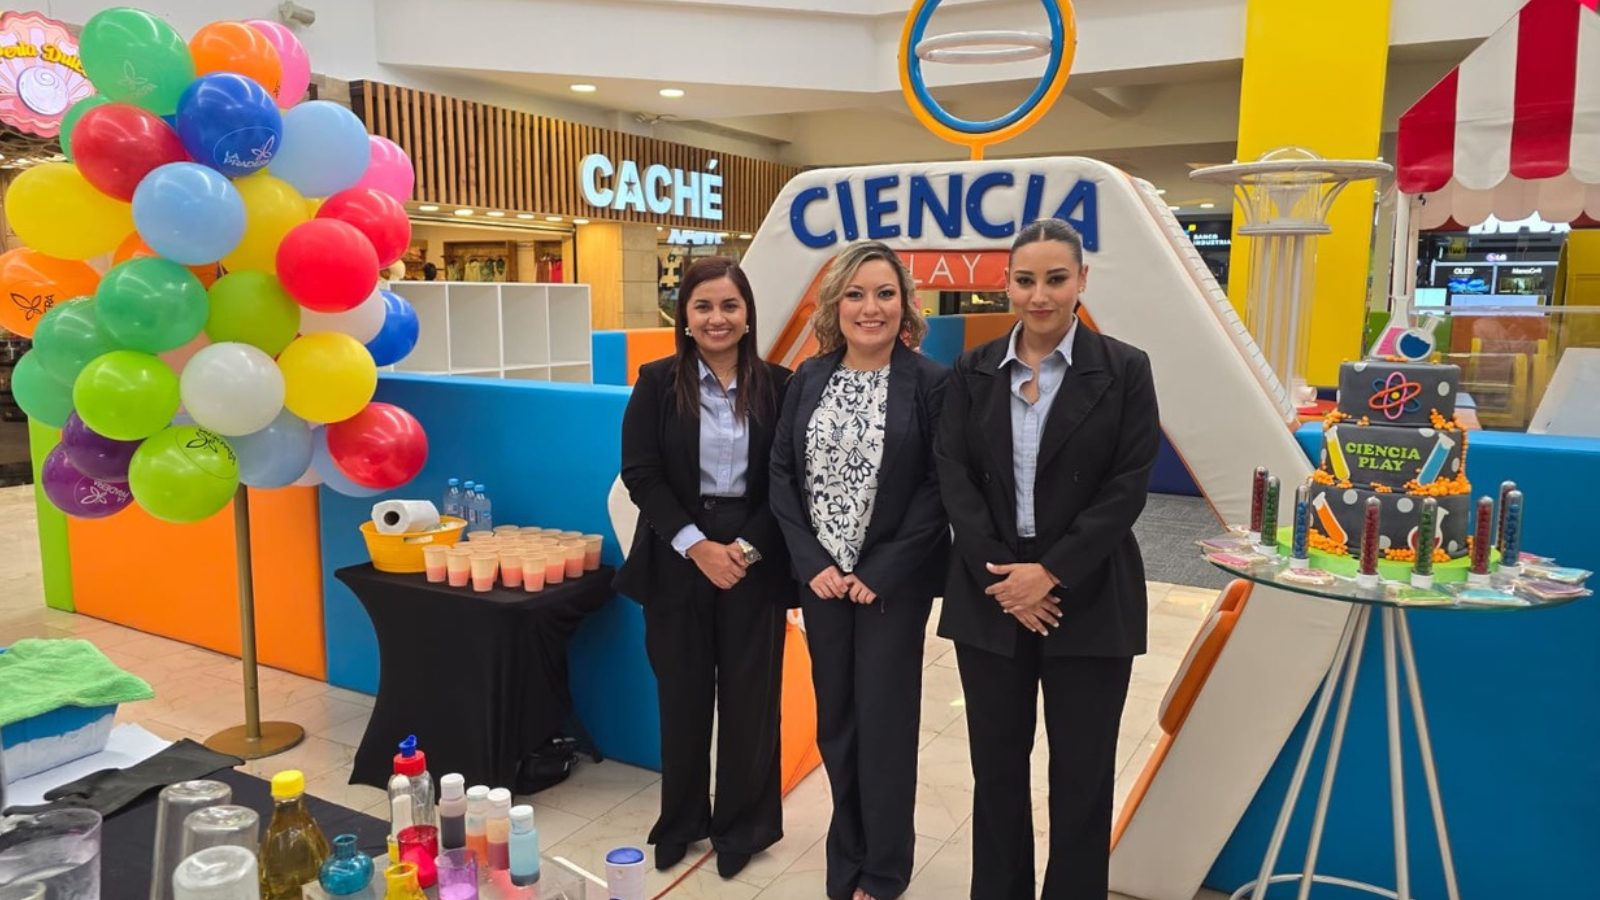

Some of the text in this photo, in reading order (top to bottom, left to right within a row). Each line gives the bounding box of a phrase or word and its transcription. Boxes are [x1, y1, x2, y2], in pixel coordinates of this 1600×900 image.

[0, 42, 88, 78] erla Dulc
[579, 153, 723, 221] CACHÉ
[790, 172, 1099, 253] CIENCIA
[909, 254, 982, 284] LAY
[1453, 267, 1475, 275] OLED
[1345, 442, 1421, 460] CIENCIA
[1358, 456, 1405, 471] PLAY
